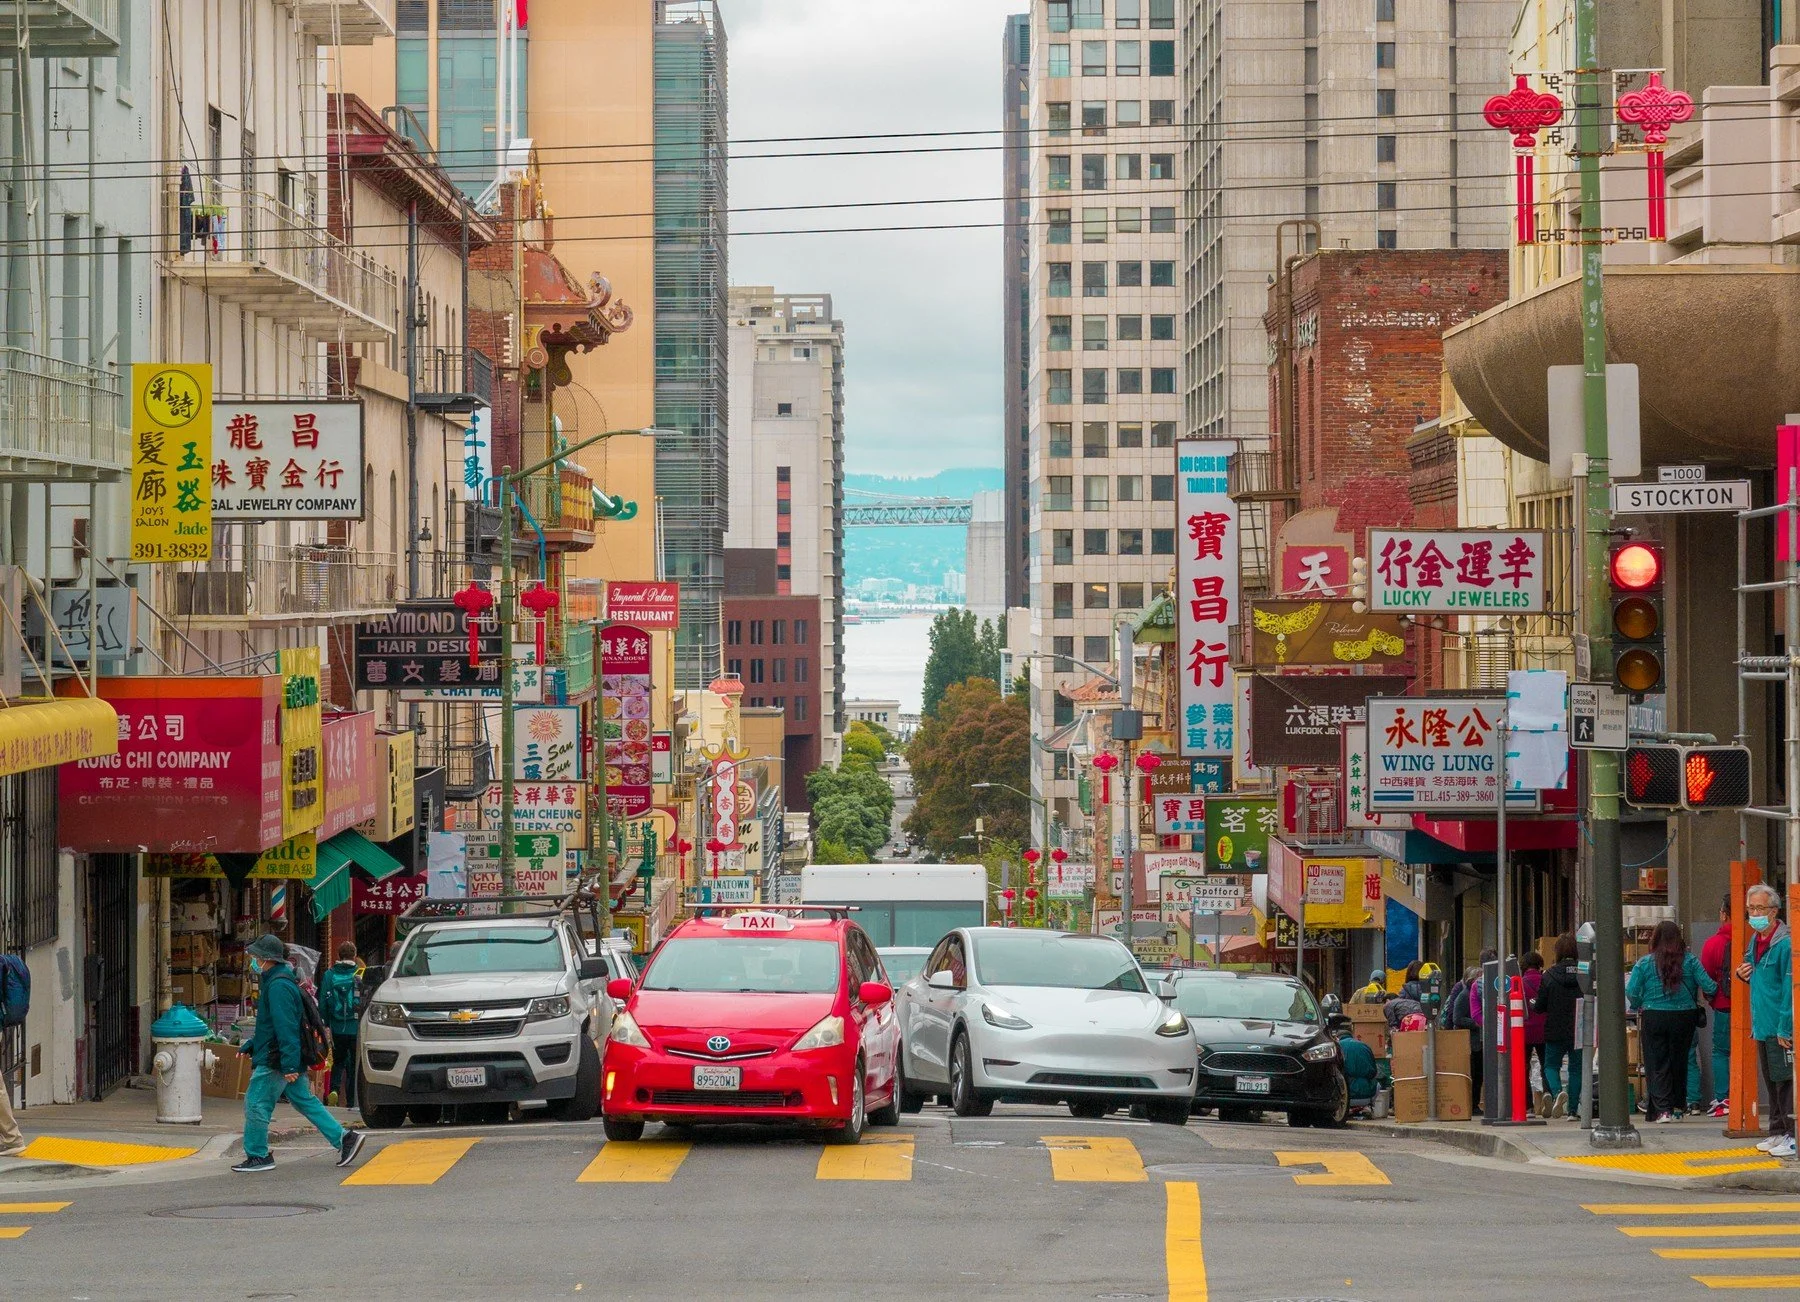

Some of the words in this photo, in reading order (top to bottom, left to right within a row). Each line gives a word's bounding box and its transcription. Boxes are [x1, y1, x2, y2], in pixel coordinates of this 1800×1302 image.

[172, 441, 207, 514] 玉器
[1673, 468, 1702, 479] 1000
[1631, 488, 1733, 507] STOCKTON
[236, 500, 293, 511] JEWELRY
[296, 500, 358, 511] COMPANY
[136, 518, 170, 527] SALON
[174, 522, 208, 535] Jade
[135, 543, 209, 559] 391-3832
[611, 588, 645, 605] Imperial
[646, 588, 675, 602] Palace
[1186, 511, 1231, 687] 寶昌行
[1383, 591, 1431, 606] LUCKY
[1447, 591, 1530, 607] JEWELERS
[611, 611, 675, 621] RESTAURANT
[366, 613, 455, 634] RAYMOND
[377, 641, 417, 653] HAIR
[1285, 727, 1323, 735] LUKFOOK
[548, 741, 574, 760] San
[126, 752, 152, 768] CHI
[156, 752, 231, 768] COMPANY
[1382, 755, 1437, 771] WING
[1442, 755, 1494, 772] LUNG
[546, 759, 571, 779] Sun
[484, 809, 503, 819] FO
[513, 809, 535, 819] WAH
[538, 809, 582, 819] CHEUNG
[489, 822, 551, 832] JEELERY
[488, 833, 497, 842] Ln
[1308, 865, 1319, 876] NO
[1320, 868, 1344, 877] PARKING
[471, 882, 545, 890] VEGERIAN
[1195, 886, 1239, 896] Spofford
[740, 917, 775, 928] TAXI
[1101, 913, 1121, 926] Lucky
[1145, 912, 1157, 920] Gift
[697, 1075, 736, 1086] 89520W1
